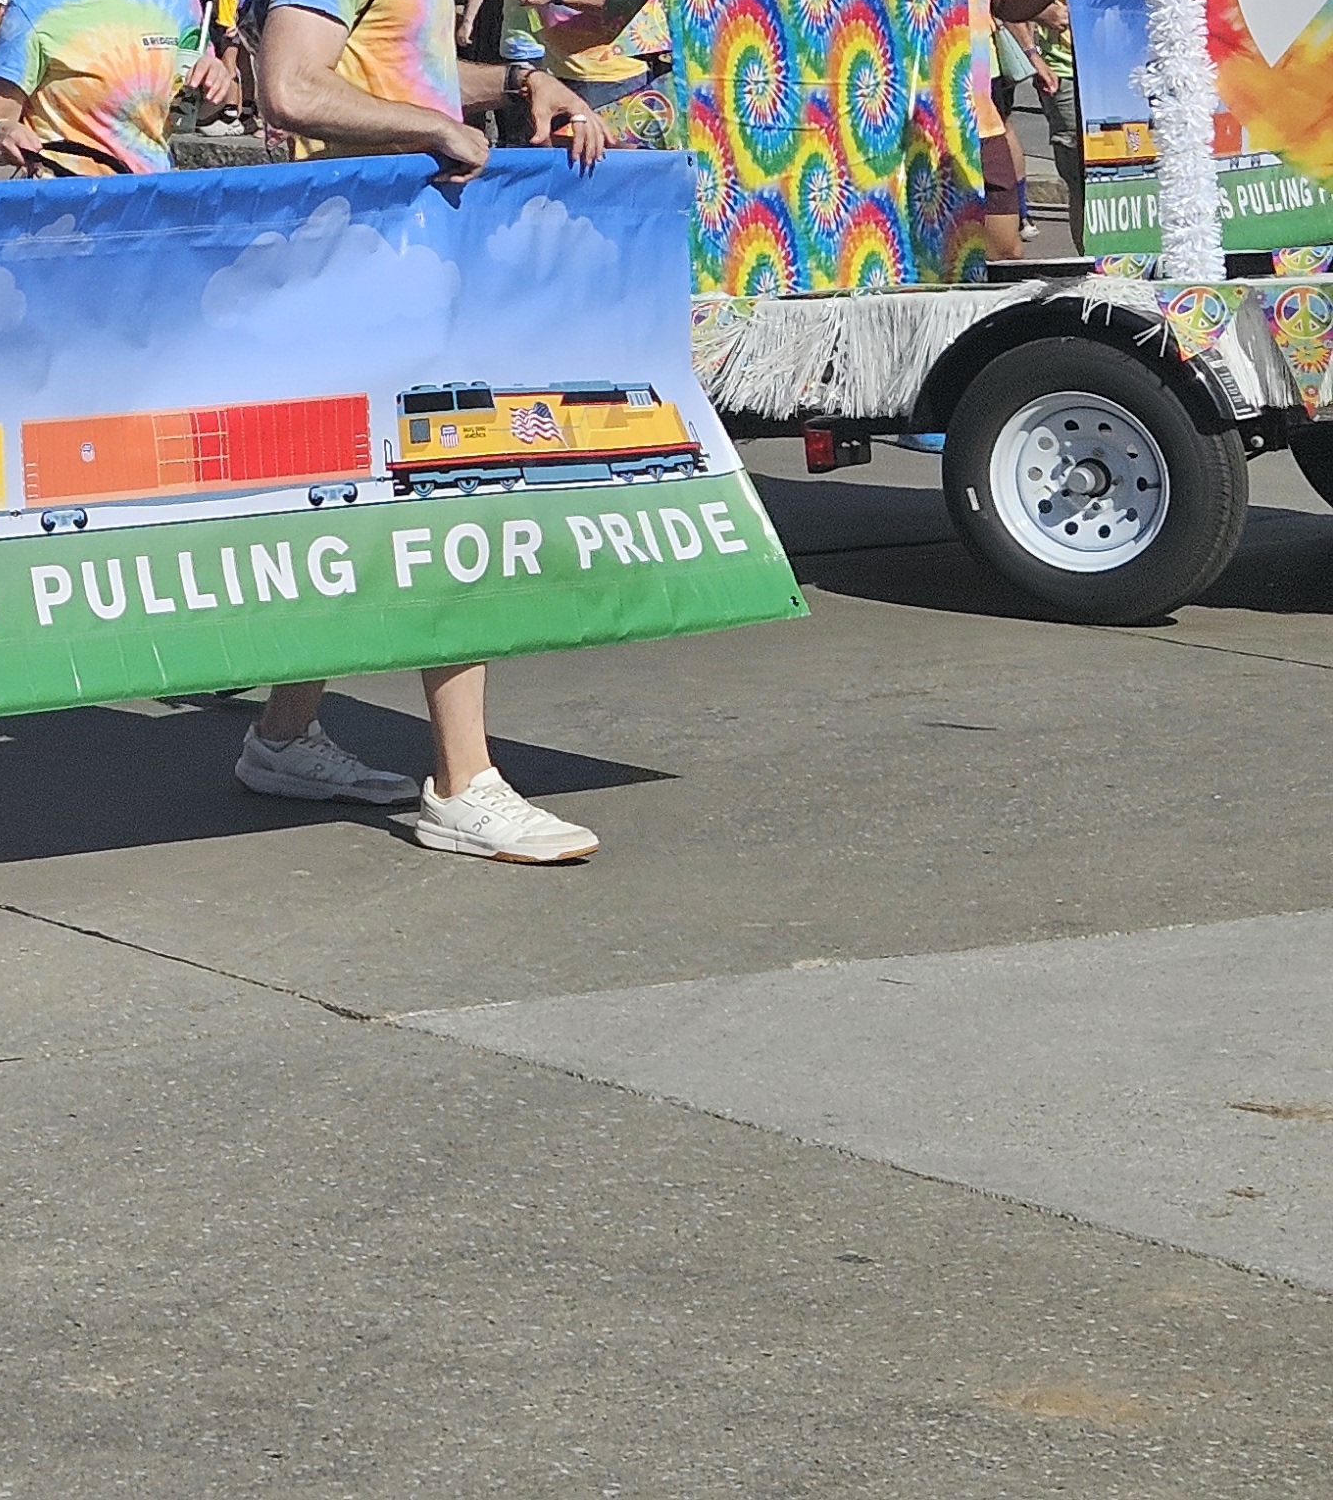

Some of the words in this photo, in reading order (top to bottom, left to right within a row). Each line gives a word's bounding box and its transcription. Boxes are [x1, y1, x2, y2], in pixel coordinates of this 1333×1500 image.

[1086, 194, 1142, 235] UNION
[1237, 176, 1313, 217] PULLING
[29, 535, 358, 626] PULLING
[391, 519, 543, 589] FOR
[565, 501, 750, 571] PRIDE
